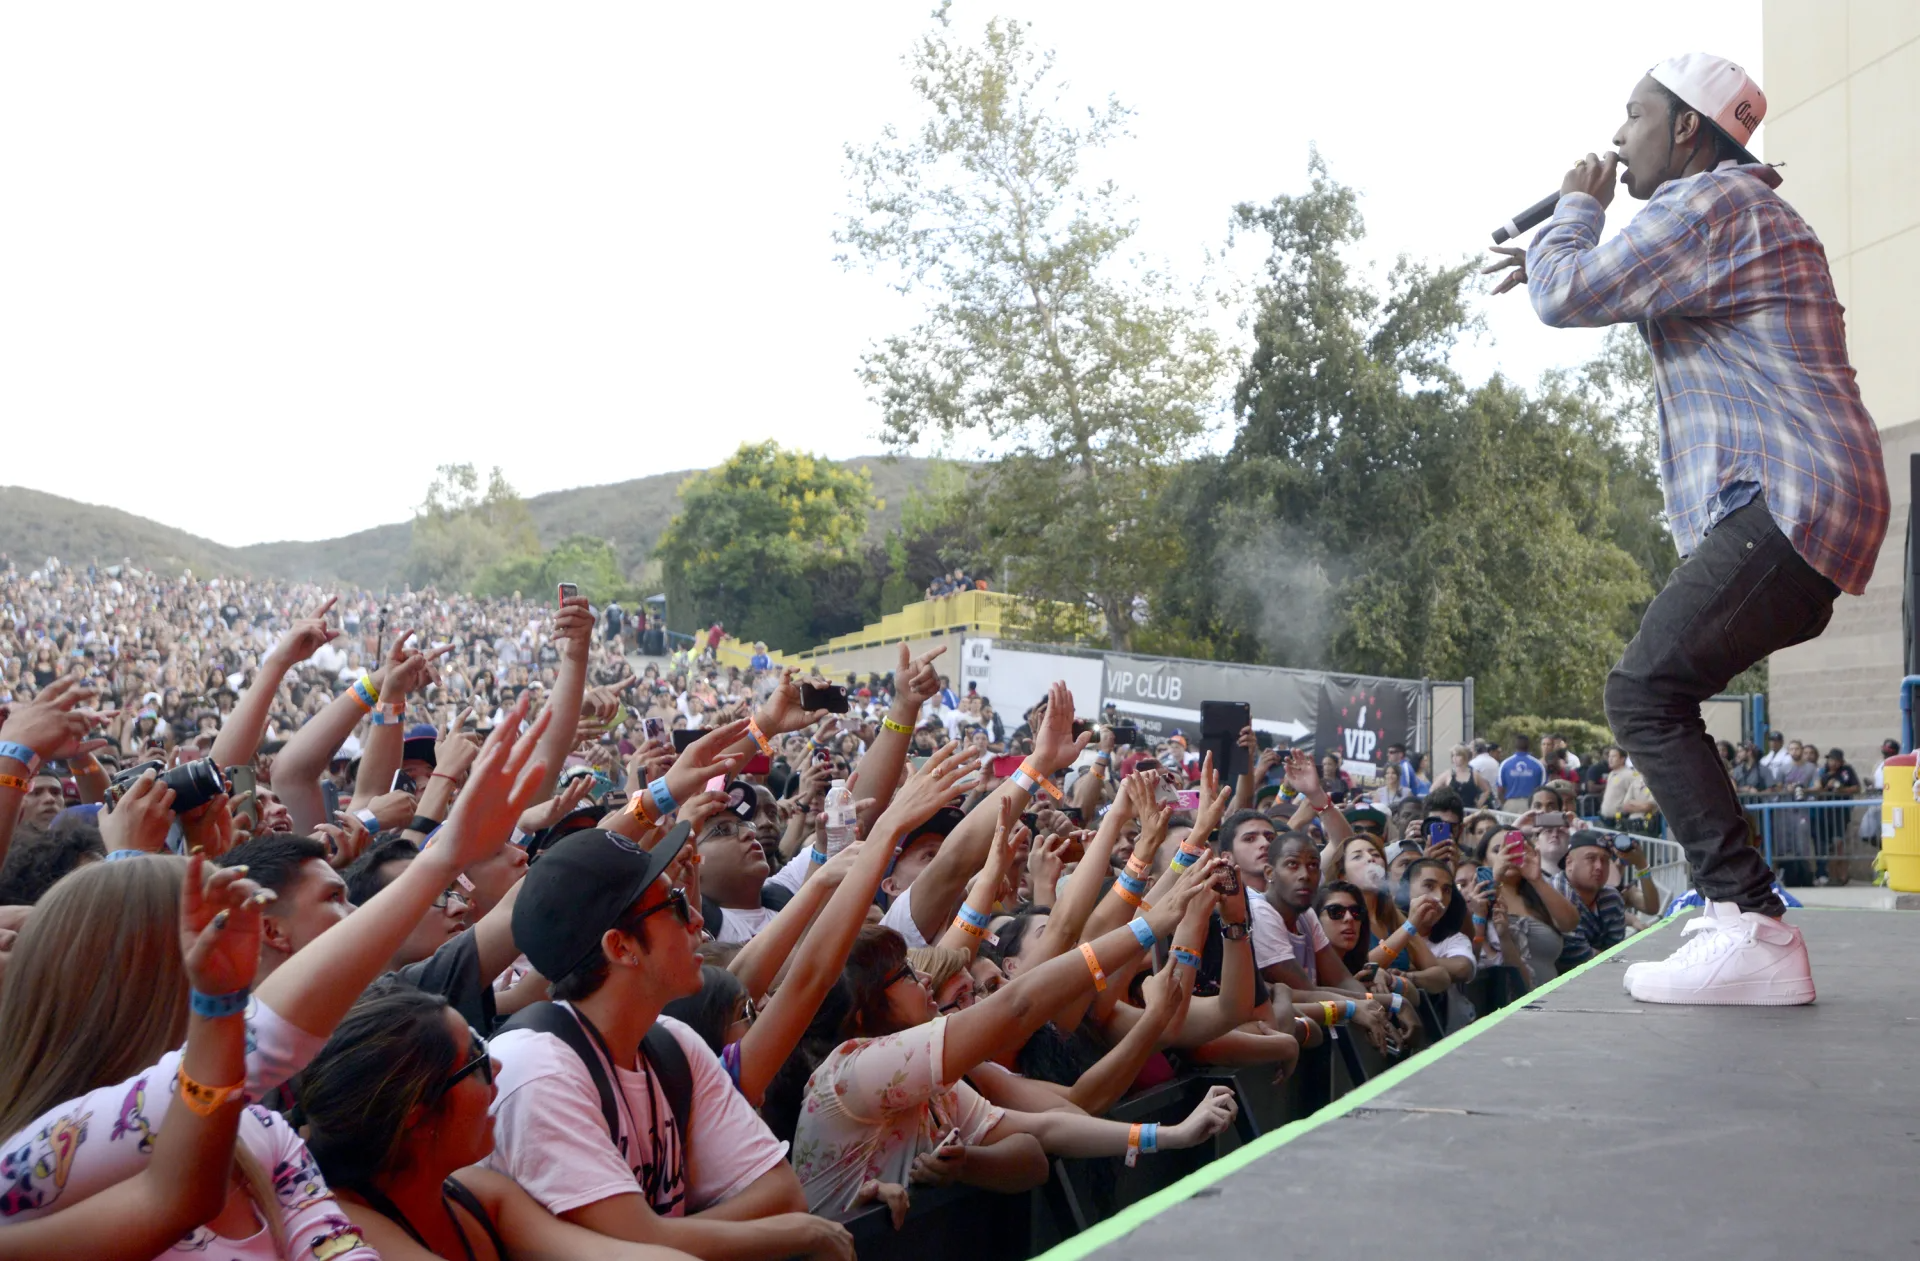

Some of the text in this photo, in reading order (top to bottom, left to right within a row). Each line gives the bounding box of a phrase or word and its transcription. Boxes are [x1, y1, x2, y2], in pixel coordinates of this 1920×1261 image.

[1107, 669, 1182, 700] VIP CLUB
[1344, 728, 1377, 761] VIP
